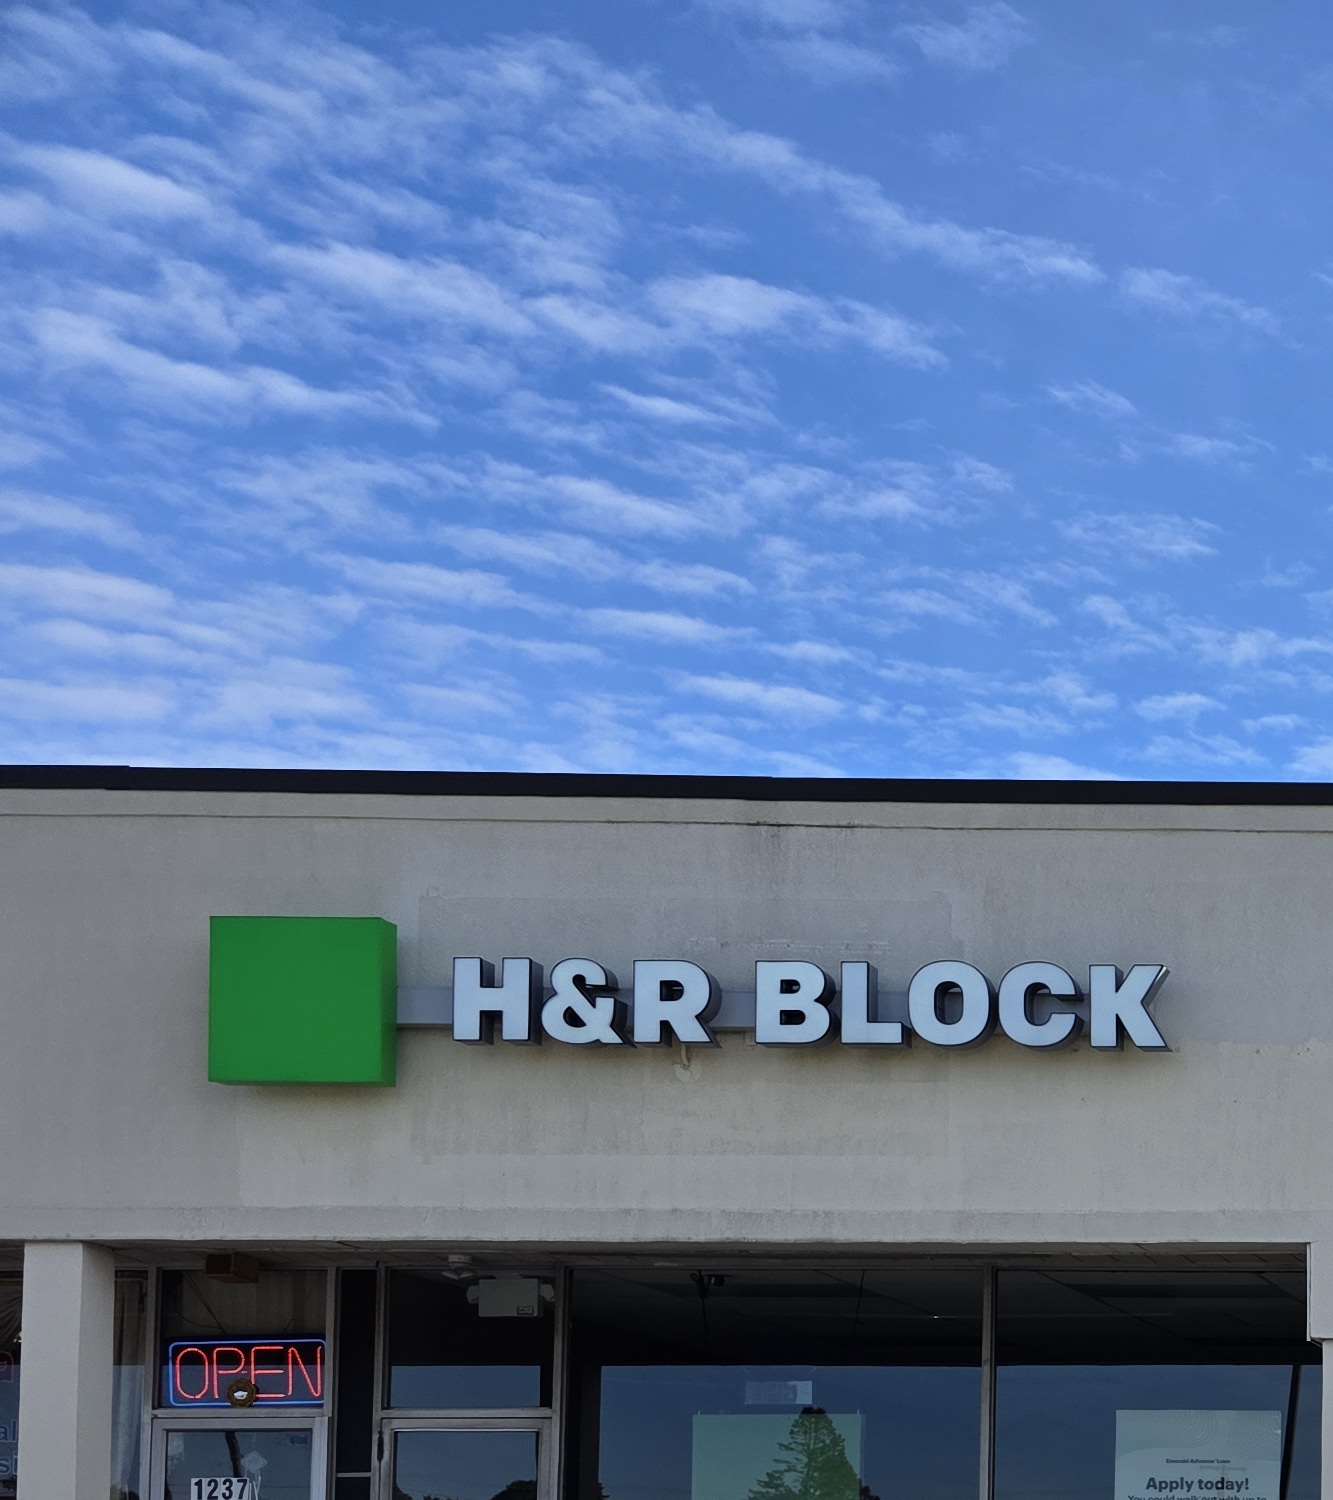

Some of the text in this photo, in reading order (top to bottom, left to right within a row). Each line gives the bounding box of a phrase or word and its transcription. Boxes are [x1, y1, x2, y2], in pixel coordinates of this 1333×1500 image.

[452, 956, 1167, 1051] H&R BLOCK
[175, 1346, 322, 1400] OPEN
[194, 1478, 249, 1500] 1237
[1145, 1477, 1249, 1492] Apply today!
